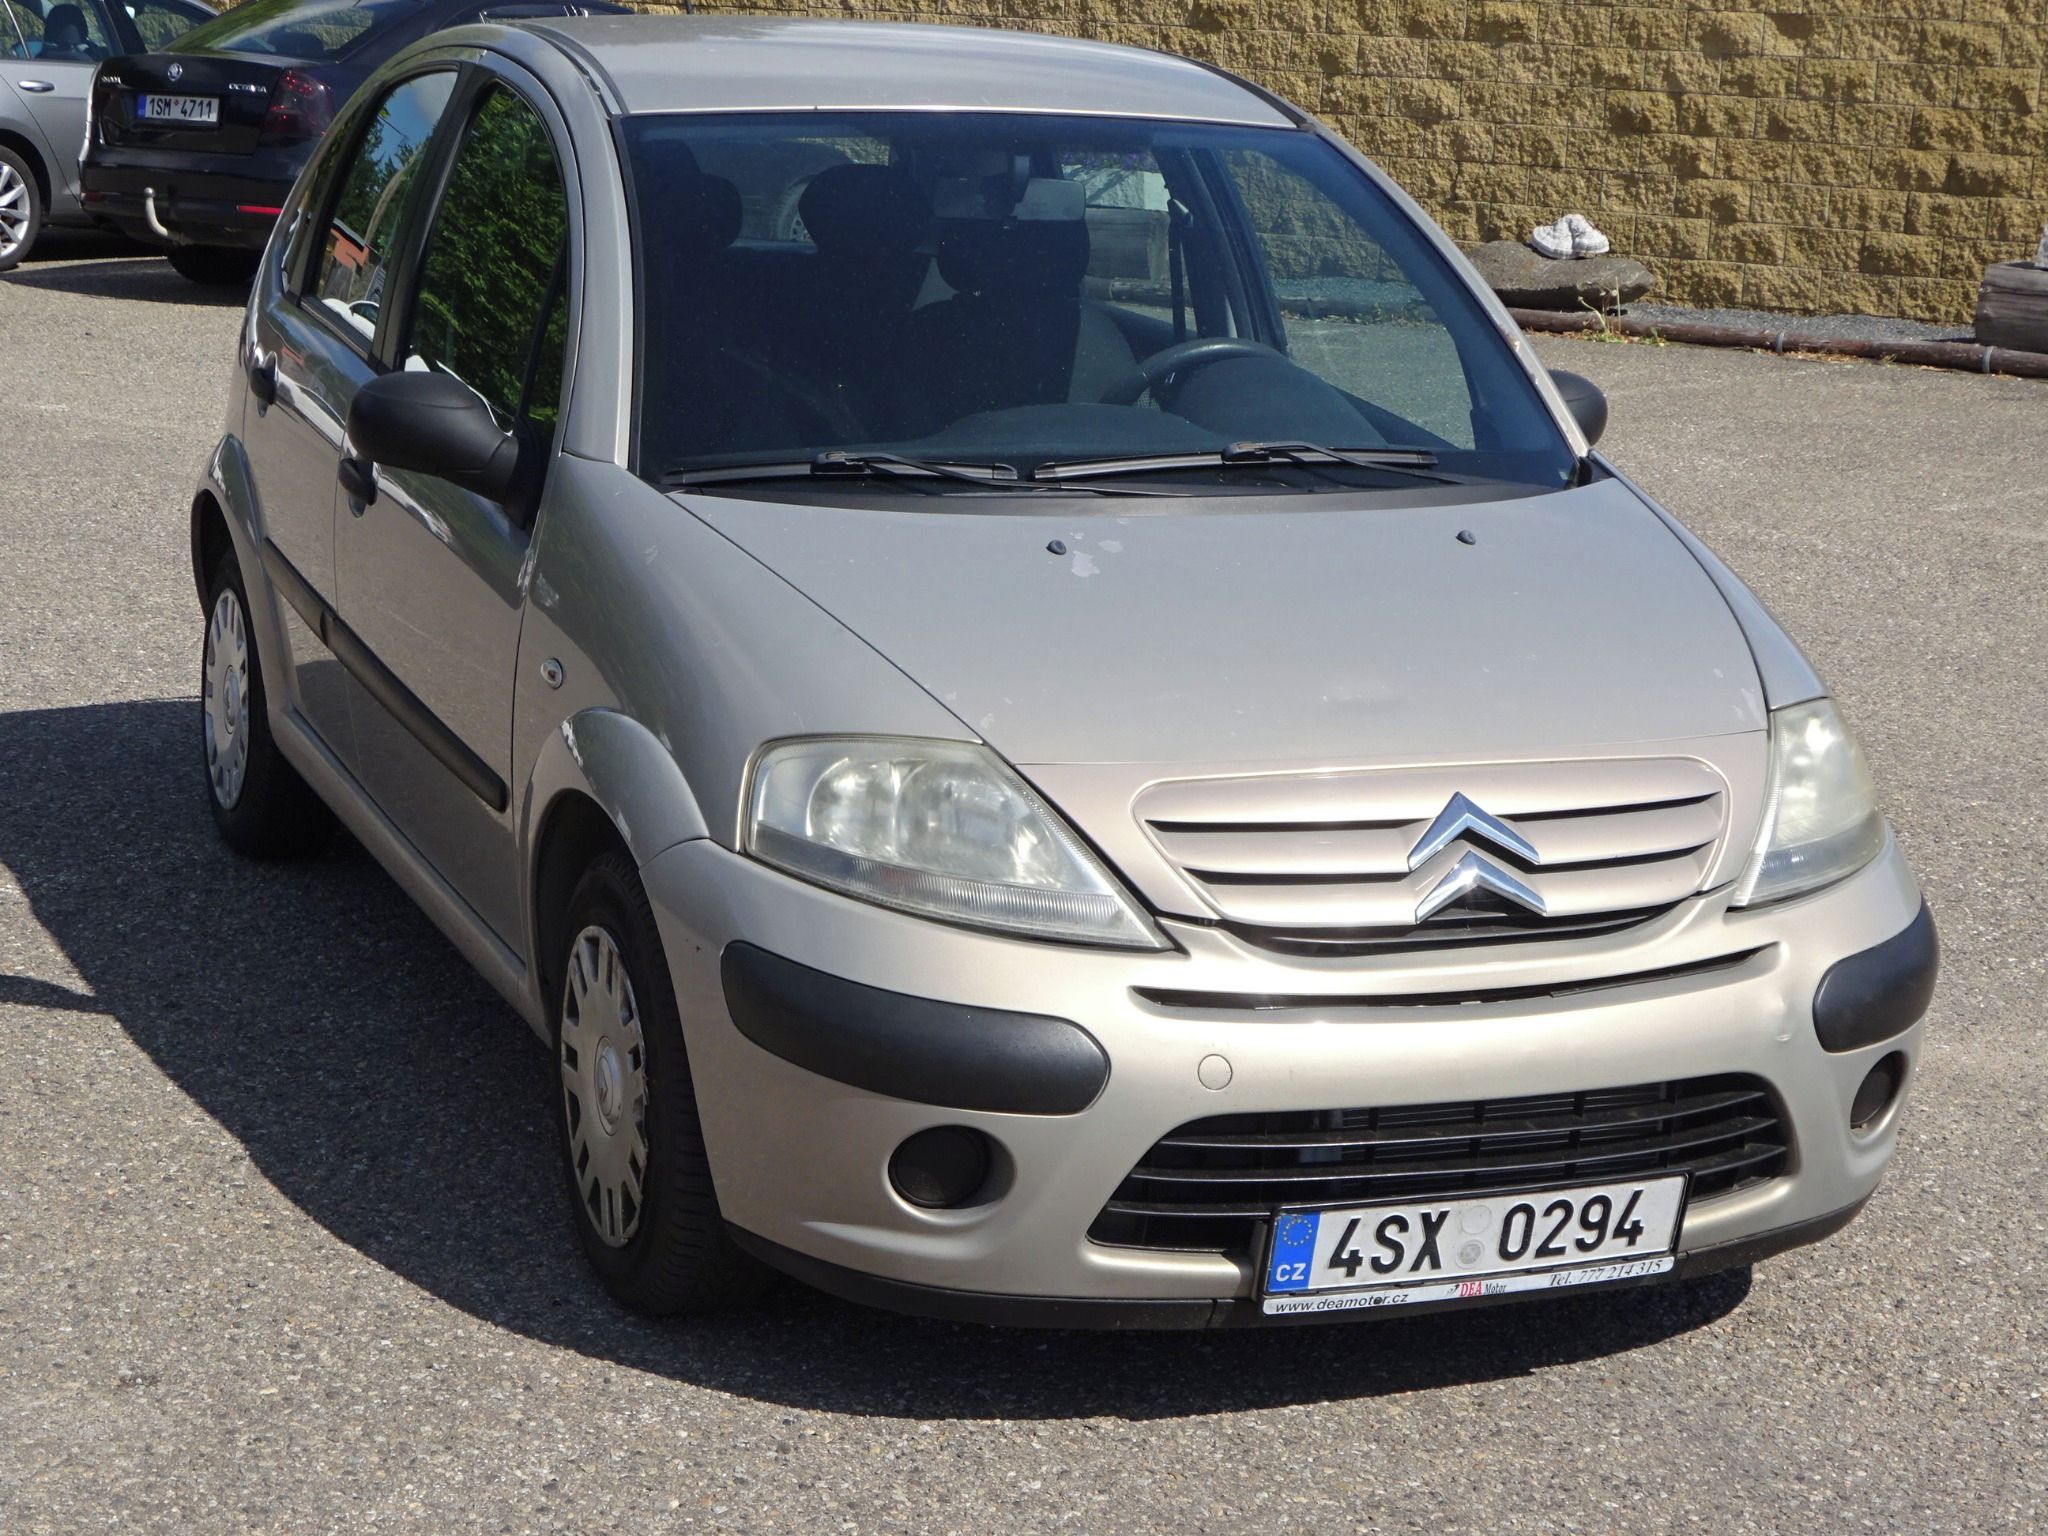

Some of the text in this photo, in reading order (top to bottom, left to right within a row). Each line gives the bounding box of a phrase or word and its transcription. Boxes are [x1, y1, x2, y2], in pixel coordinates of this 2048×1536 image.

[149, 97, 212, 118] 1SM 4711
[1329, 1189, 1644, 1277] 4SX 0294
[1275, 1262, 1307, 1282] CZ
[1549, 1259, 1663, 1286] Tel. 777 214 315
[1460, 1281, 1507, 1297] DEA Motor
